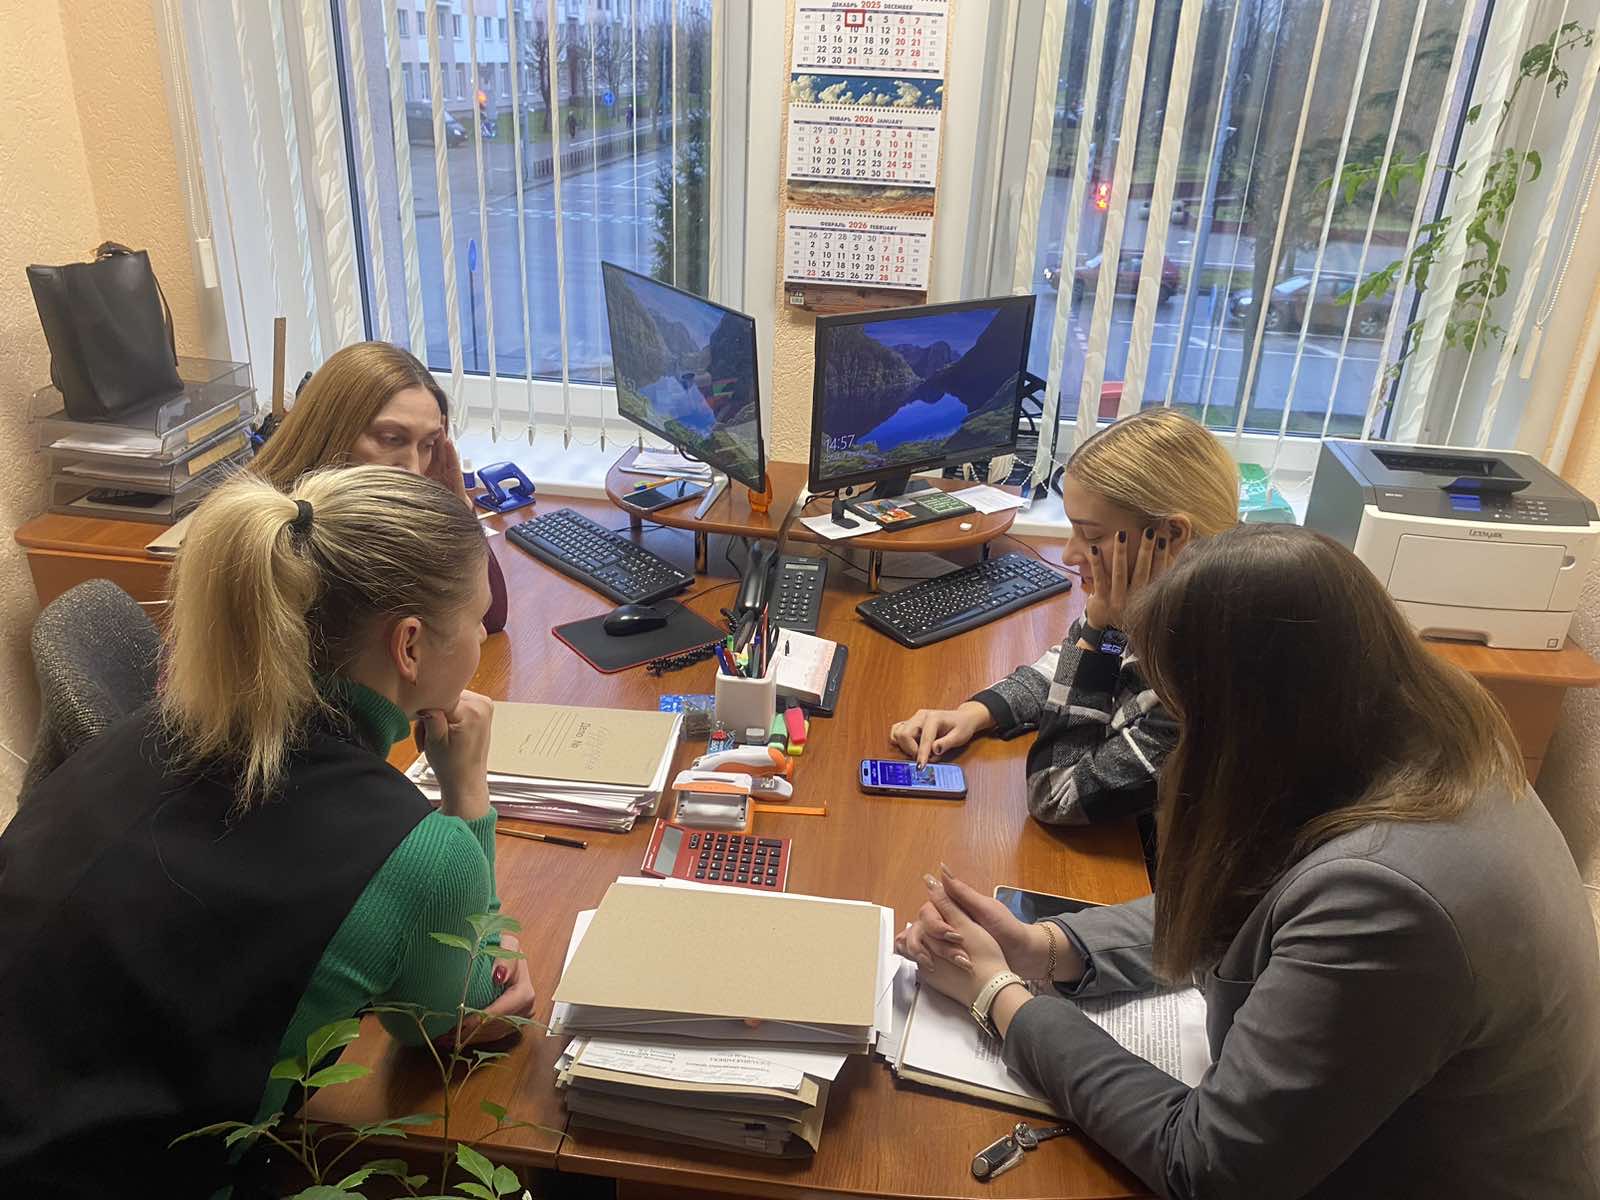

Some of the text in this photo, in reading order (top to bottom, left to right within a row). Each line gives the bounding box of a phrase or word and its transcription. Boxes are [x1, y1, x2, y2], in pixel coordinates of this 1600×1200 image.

[897, 27, 906, 35] 13
[865, 36, 874, 44] 18
[911, 38, 921, 46] 21
[824, 433, 855, 452] 14:57
